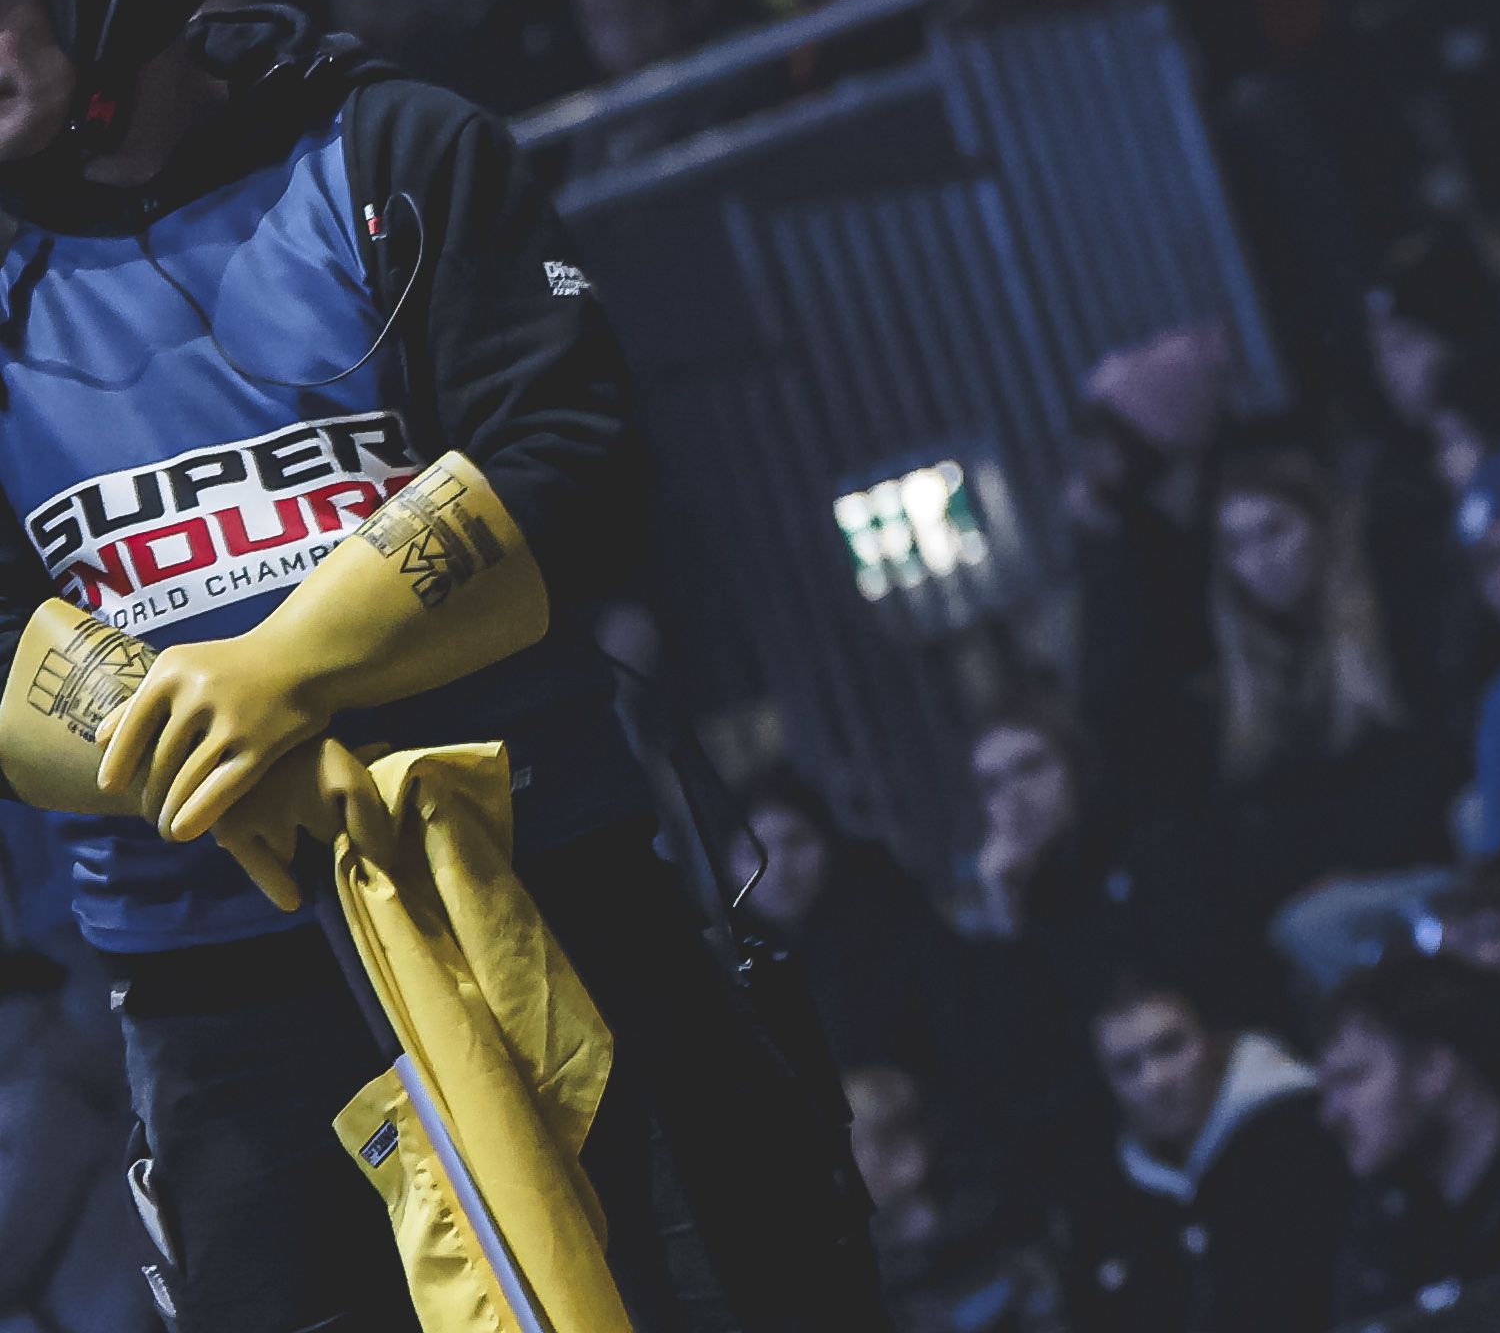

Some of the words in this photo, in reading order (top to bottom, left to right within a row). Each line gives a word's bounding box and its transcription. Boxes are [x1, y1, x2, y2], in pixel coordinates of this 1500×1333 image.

[28, 419, 427, 570] SUPER
[112, 584, 190, 631] ORLD
[204, 537, 340, 597] CHAMP
